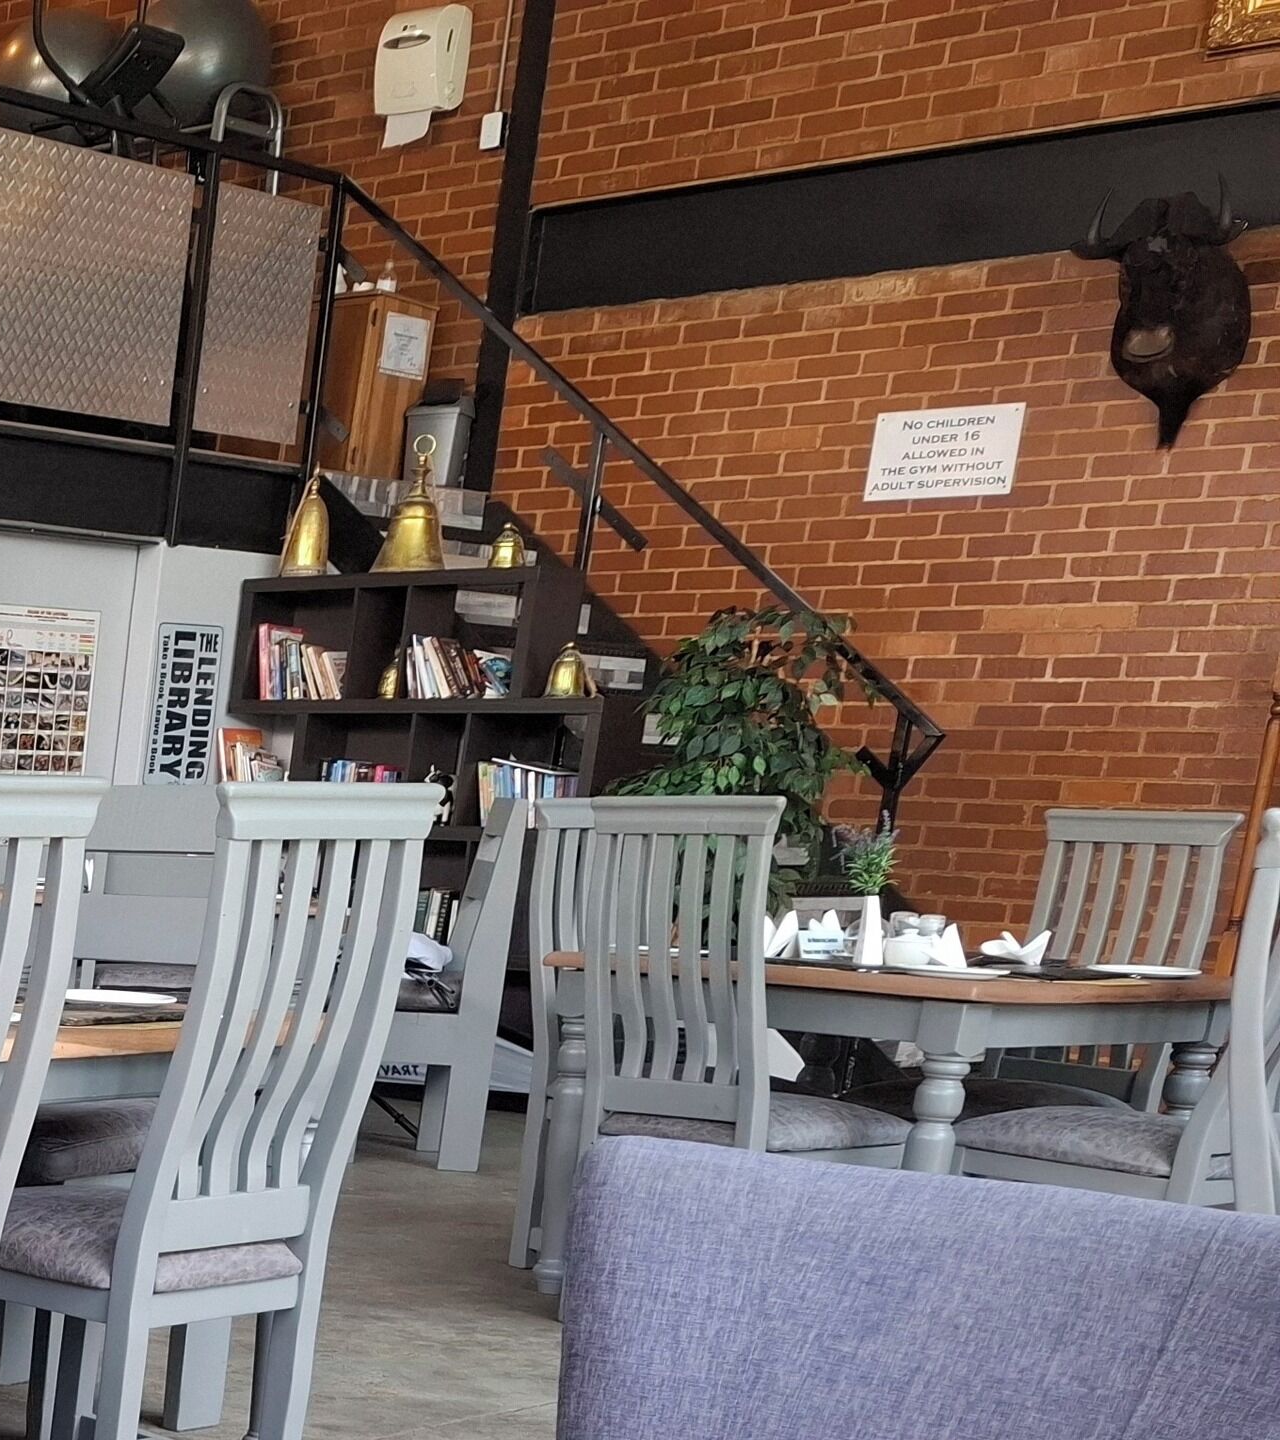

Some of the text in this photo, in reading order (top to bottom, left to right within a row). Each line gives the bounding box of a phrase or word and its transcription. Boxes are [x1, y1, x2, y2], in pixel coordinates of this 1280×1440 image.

[926, 416, 996, 429] CHILDREN
[912, 431, 981, 445] UNDER 16
[901, 447, 985, 461] ALLOWED IN
[881, 461, 1004, 477] THE GYM WITHOUT
[871, 476, 1007, 492] ADULT SUPERVISION
[161, 634, 171, 660] Take
[199, 633, 219, 653] THE
[159, 631, 197, 779] LIBRARY
[153, 704, 163, 736] Leave
[185, 657, 217, 780] LENDING
[148, 746, 157, 775] Book
